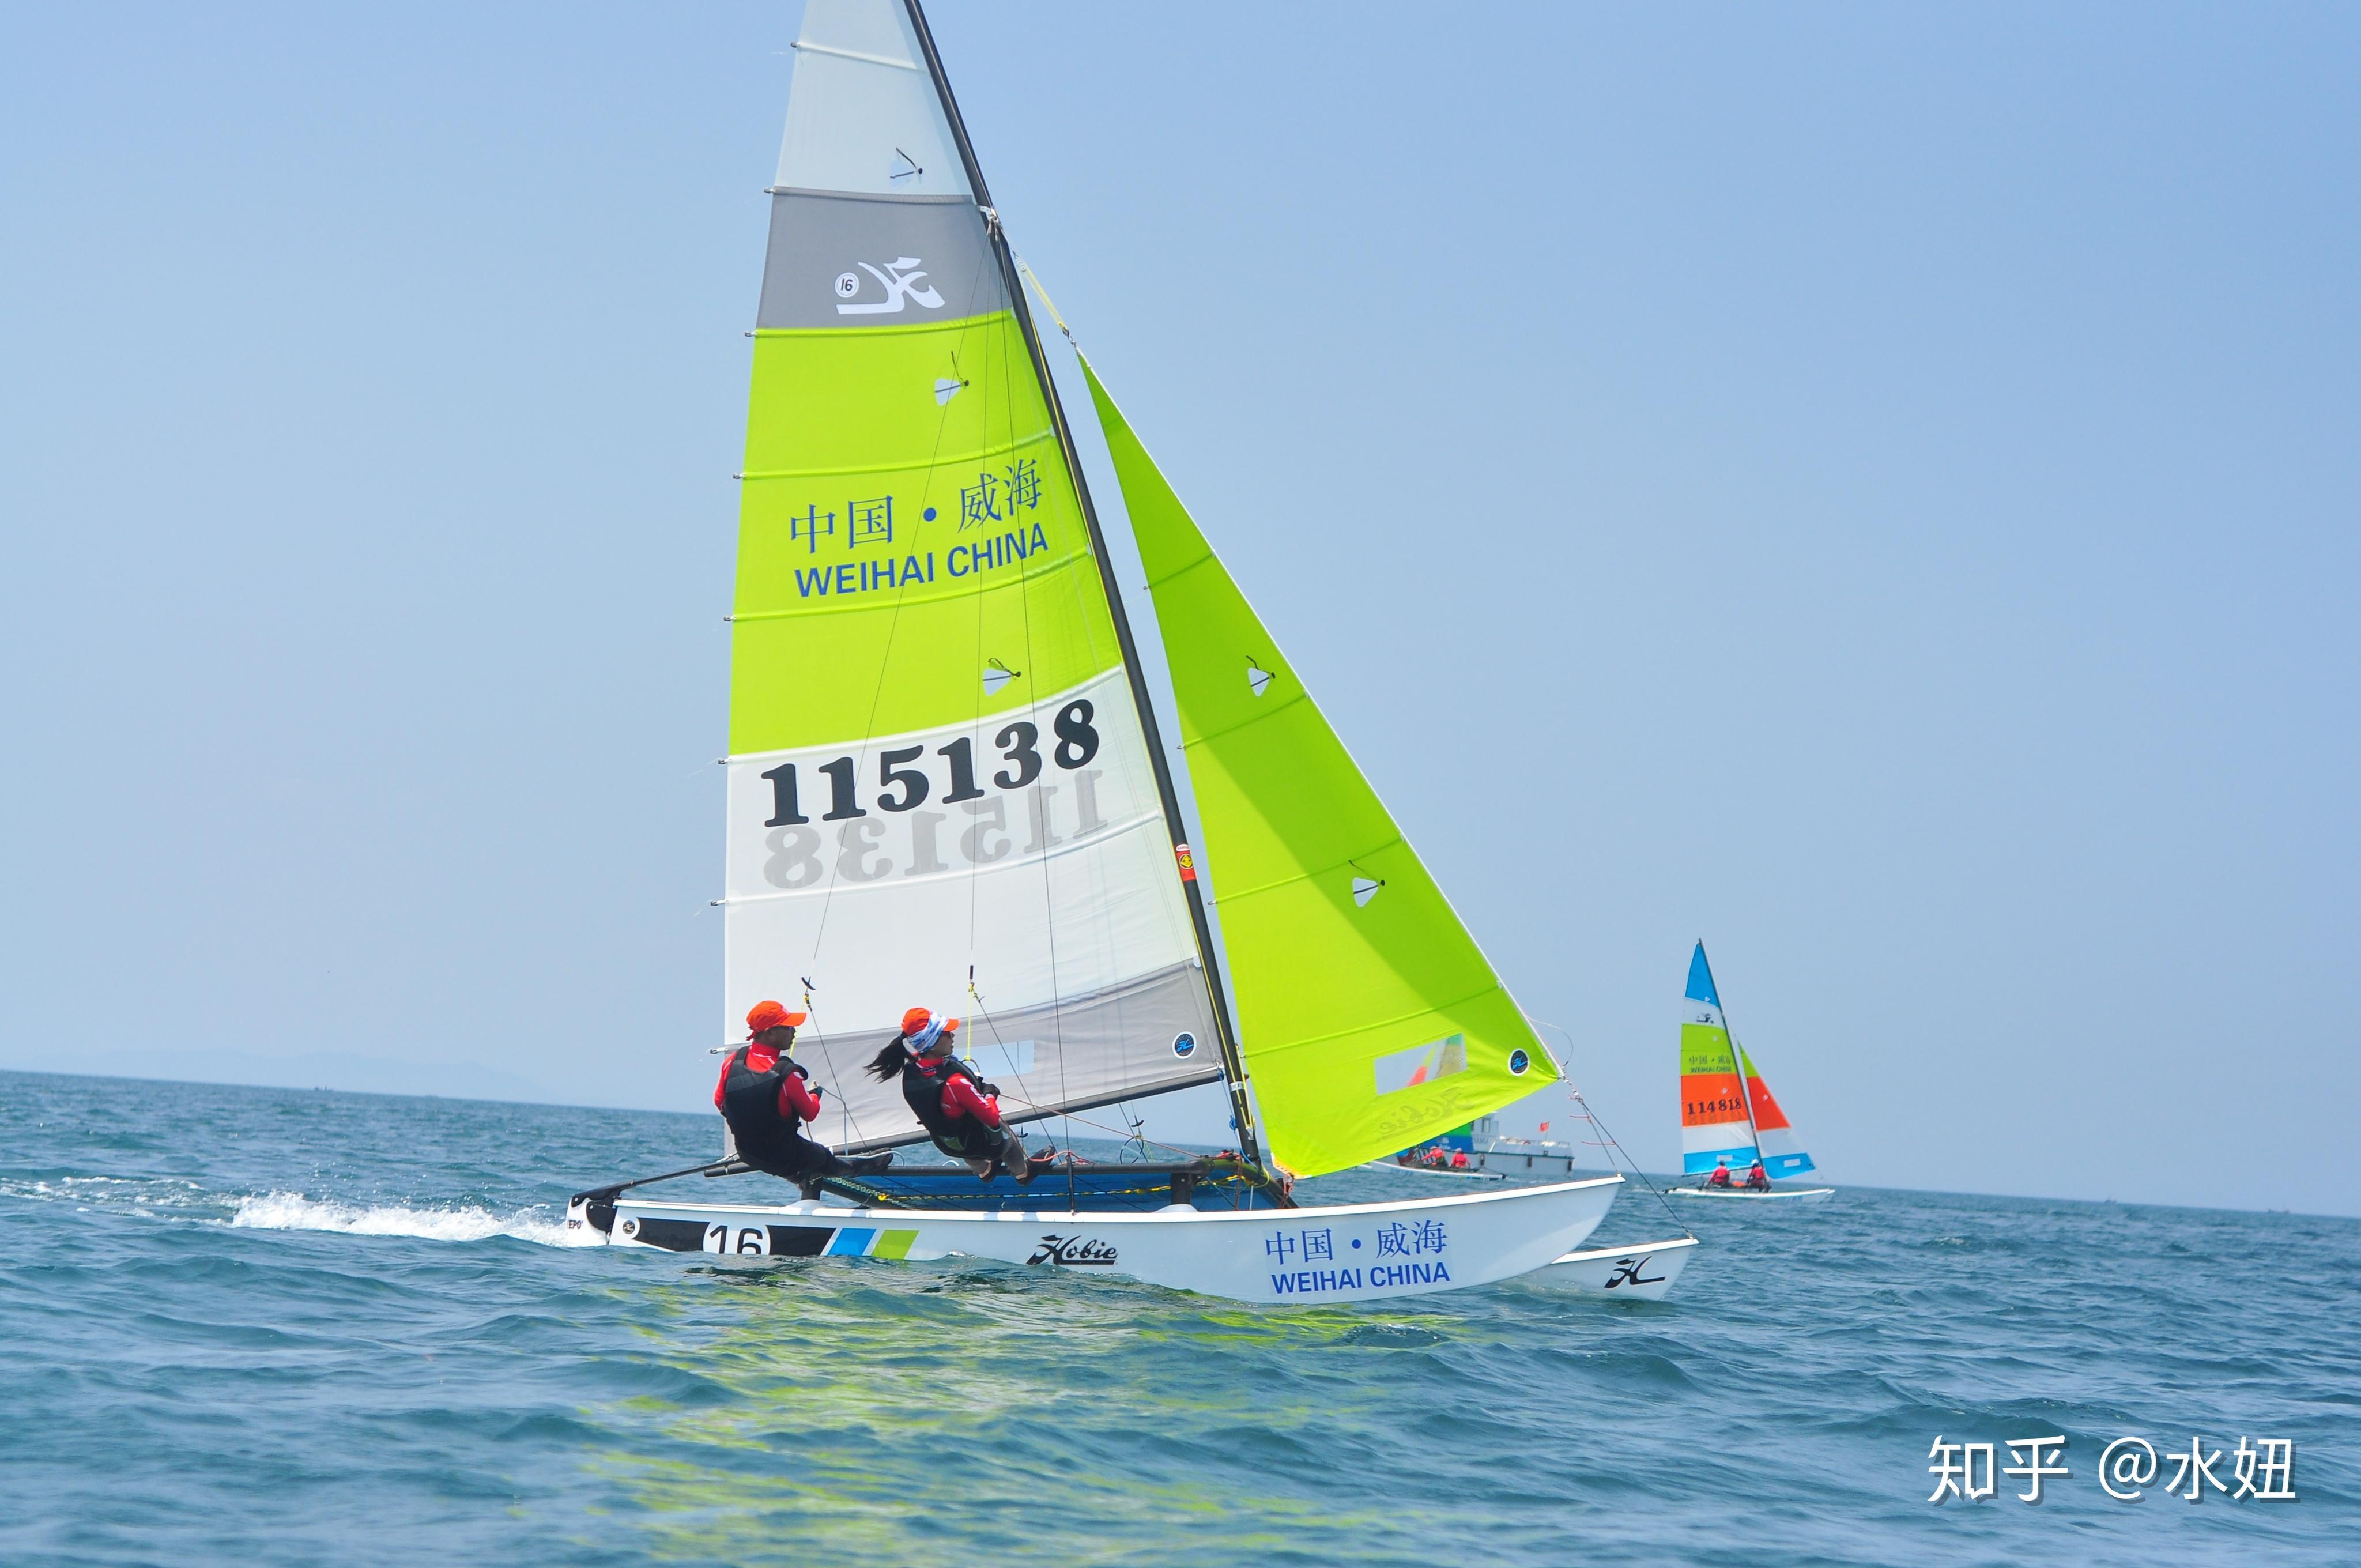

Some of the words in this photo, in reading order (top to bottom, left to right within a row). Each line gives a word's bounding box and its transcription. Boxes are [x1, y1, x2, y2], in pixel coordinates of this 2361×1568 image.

[840, 278, 853, 291] 16
[794, 552, 935, 598] WEIHAI
[947, 521, 1049, 578] CHINA
[761, 699, 1099, 828] 115138
[1687, 1097, 1741, 1115] 114818
[709, 1224, 763, 1254] 16
[1025, 1234, 1118, 1265] Hobie
[1271, 1268, 1362, 1294] WEIHAI
[1370, 1262, 1451, 1287] CHINA
